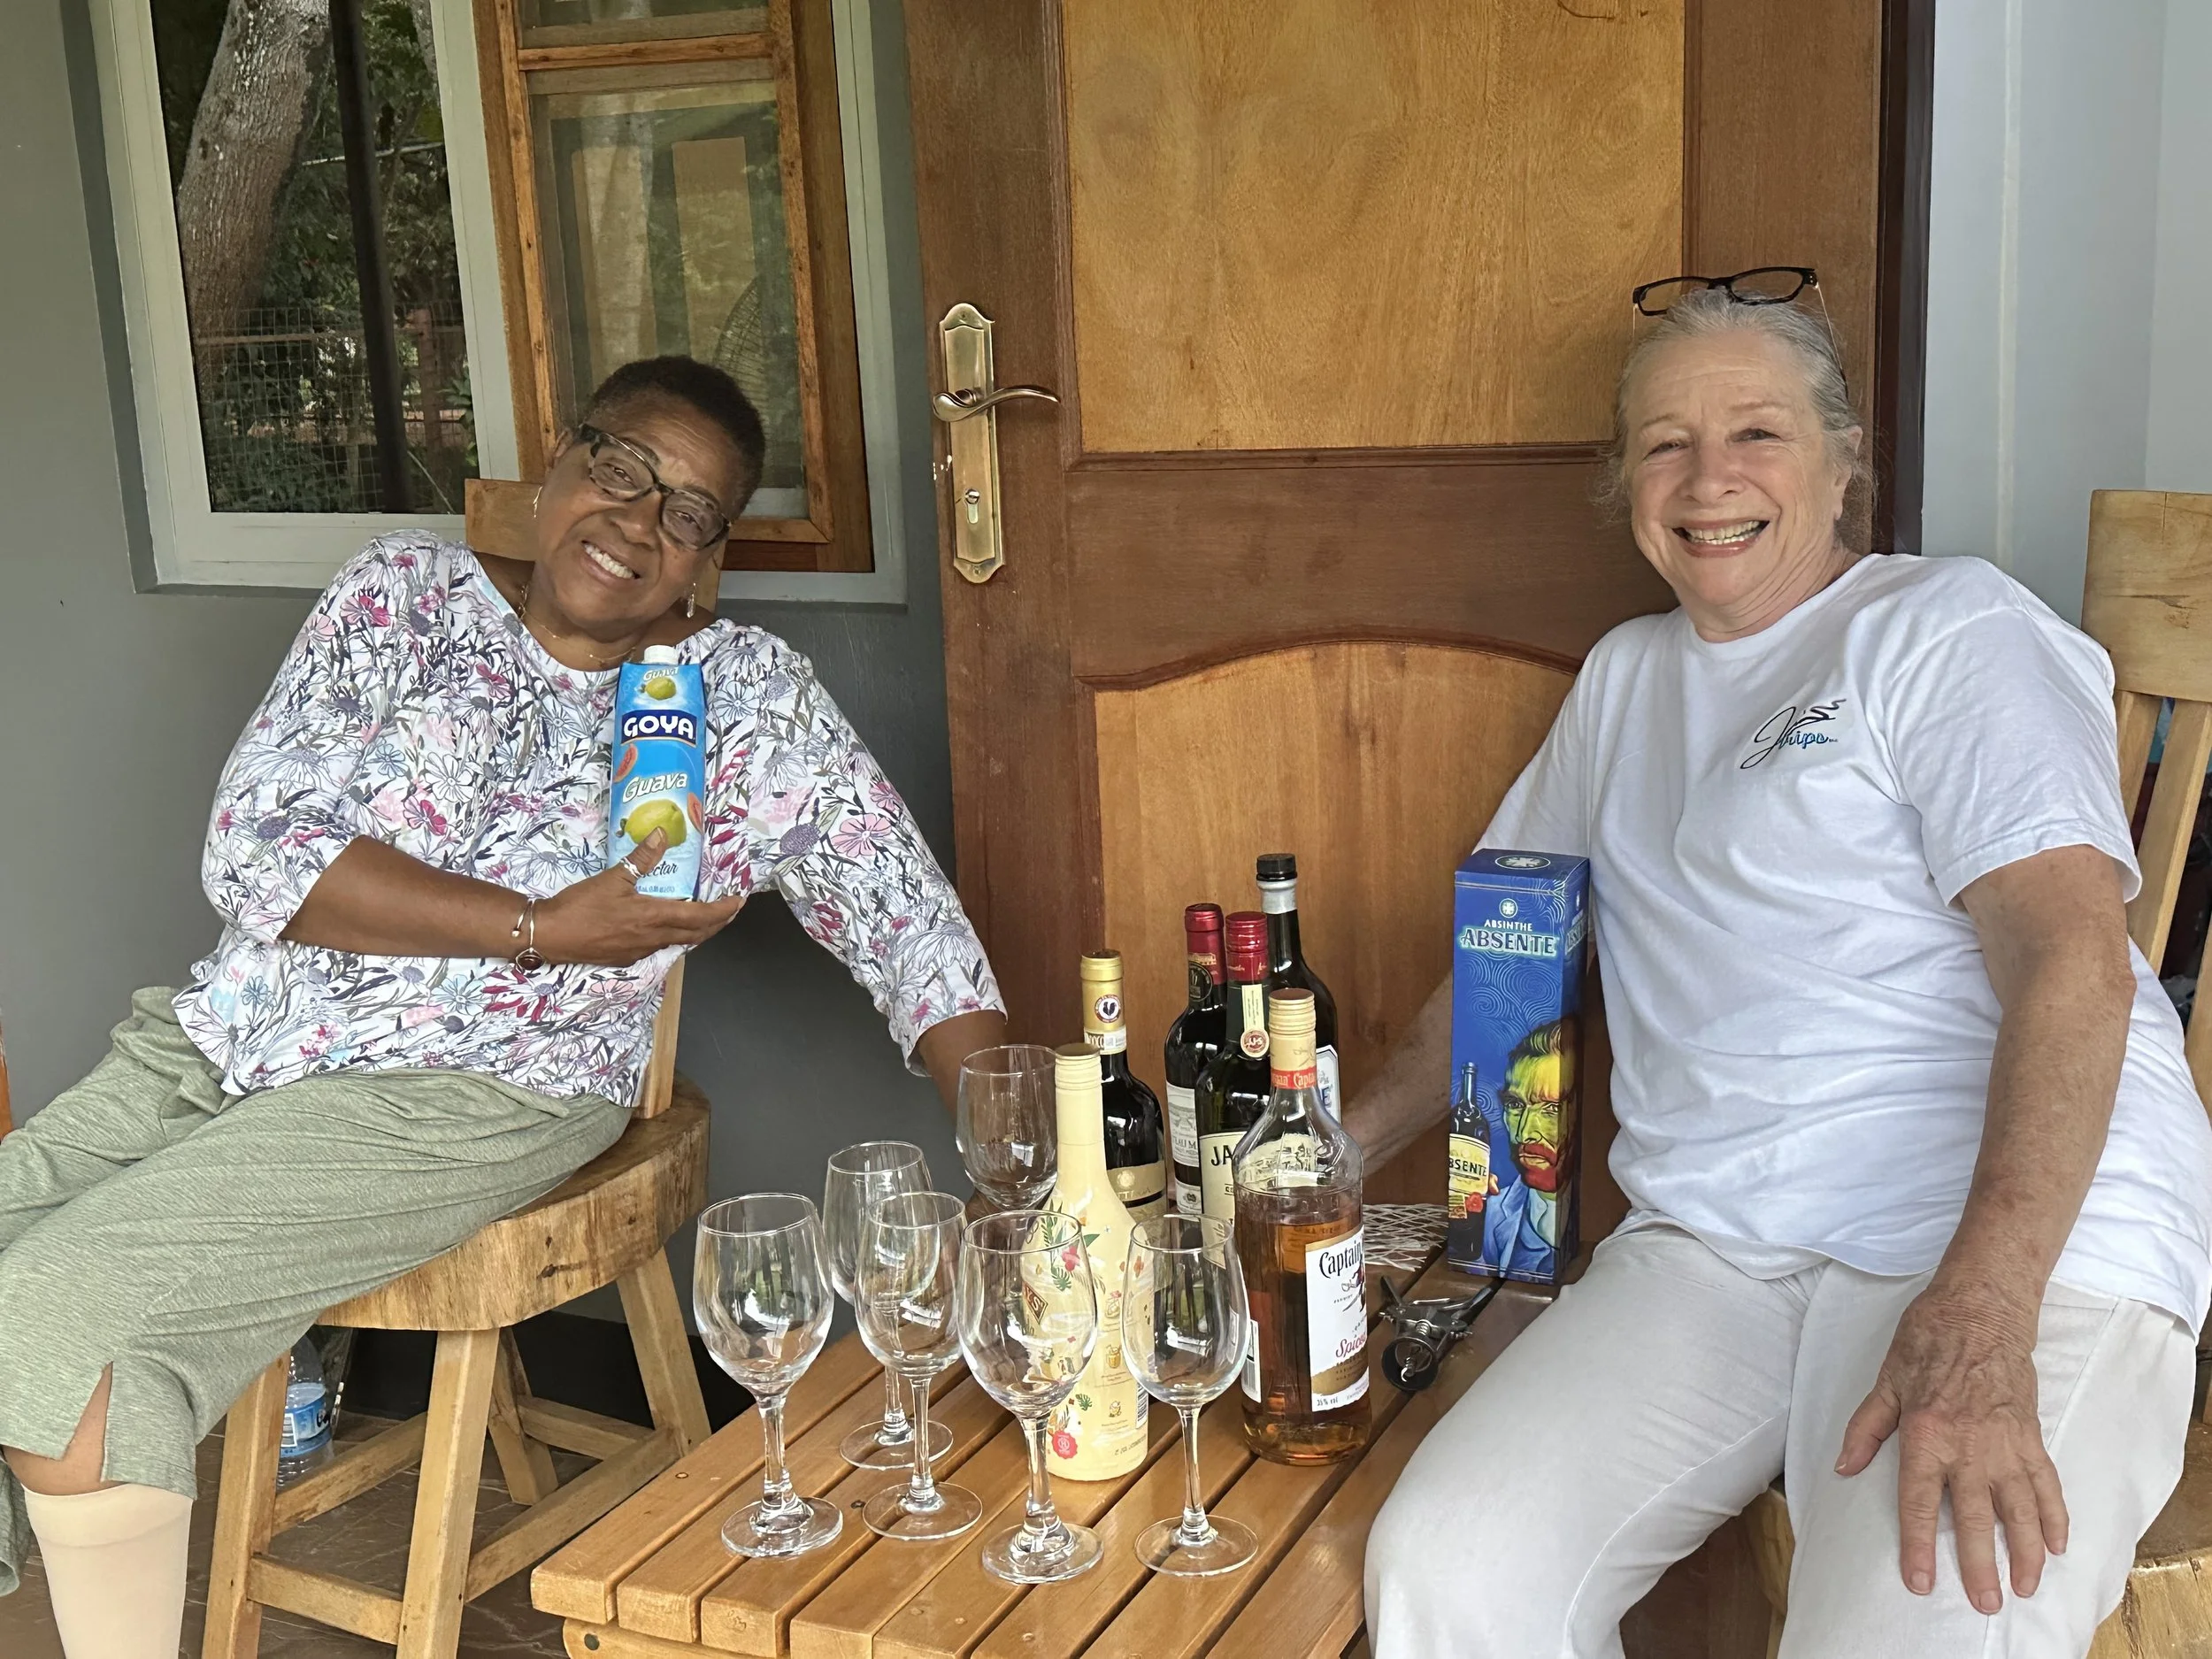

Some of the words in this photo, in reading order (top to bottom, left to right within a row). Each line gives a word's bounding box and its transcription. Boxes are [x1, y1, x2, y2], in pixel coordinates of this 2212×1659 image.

[623, 715, 694, 740] GOYA
[622, 772, 687, 803] Guava
[643, 861, 678, 878] ctar
[1484, 919, 1533, 932] ABSINTHE
[1460, 927, 1556, 955] ABSENTE
[1449, 1157, 1487, 1177] BSENTE
